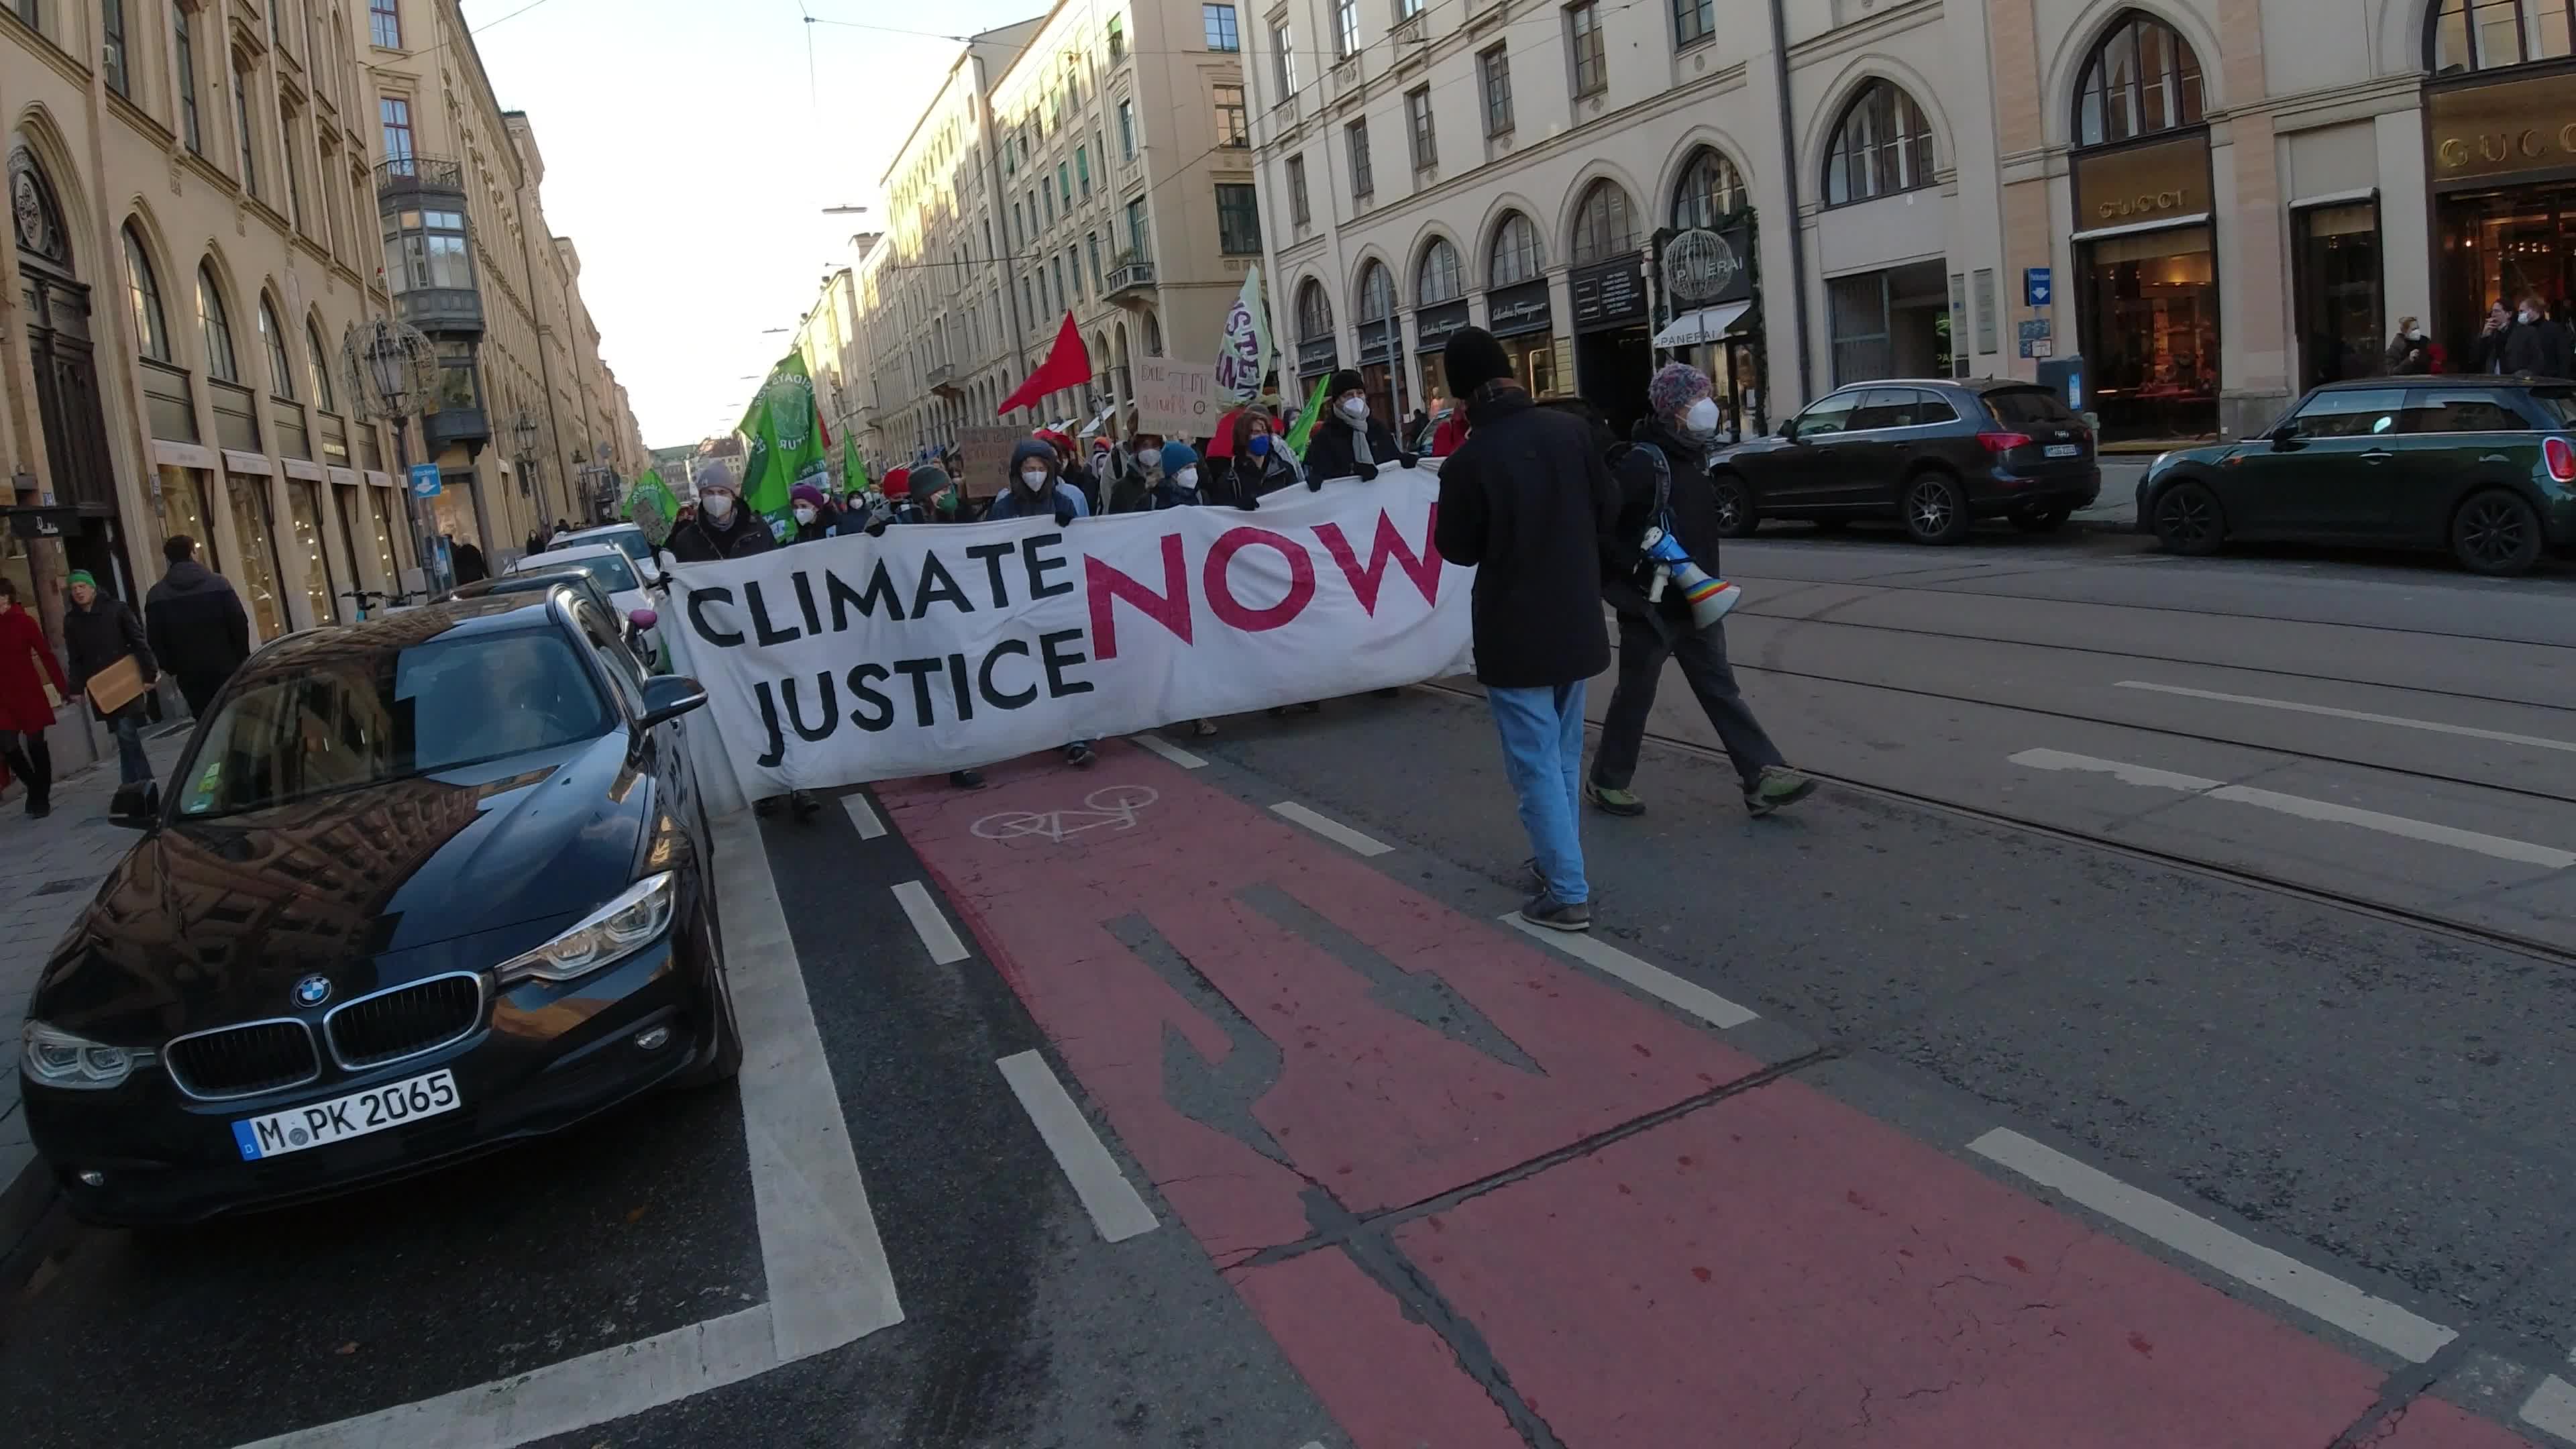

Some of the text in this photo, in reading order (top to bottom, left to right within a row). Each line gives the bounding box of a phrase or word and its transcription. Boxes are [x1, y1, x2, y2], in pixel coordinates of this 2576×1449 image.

[688, 533, 1073, 647] CLIMATE
[1084, 502, 1444, 660] NOW
[753, 628, 1094, 767] JUSTICE
[256, 1074, 453, 1150] M PK 2065
